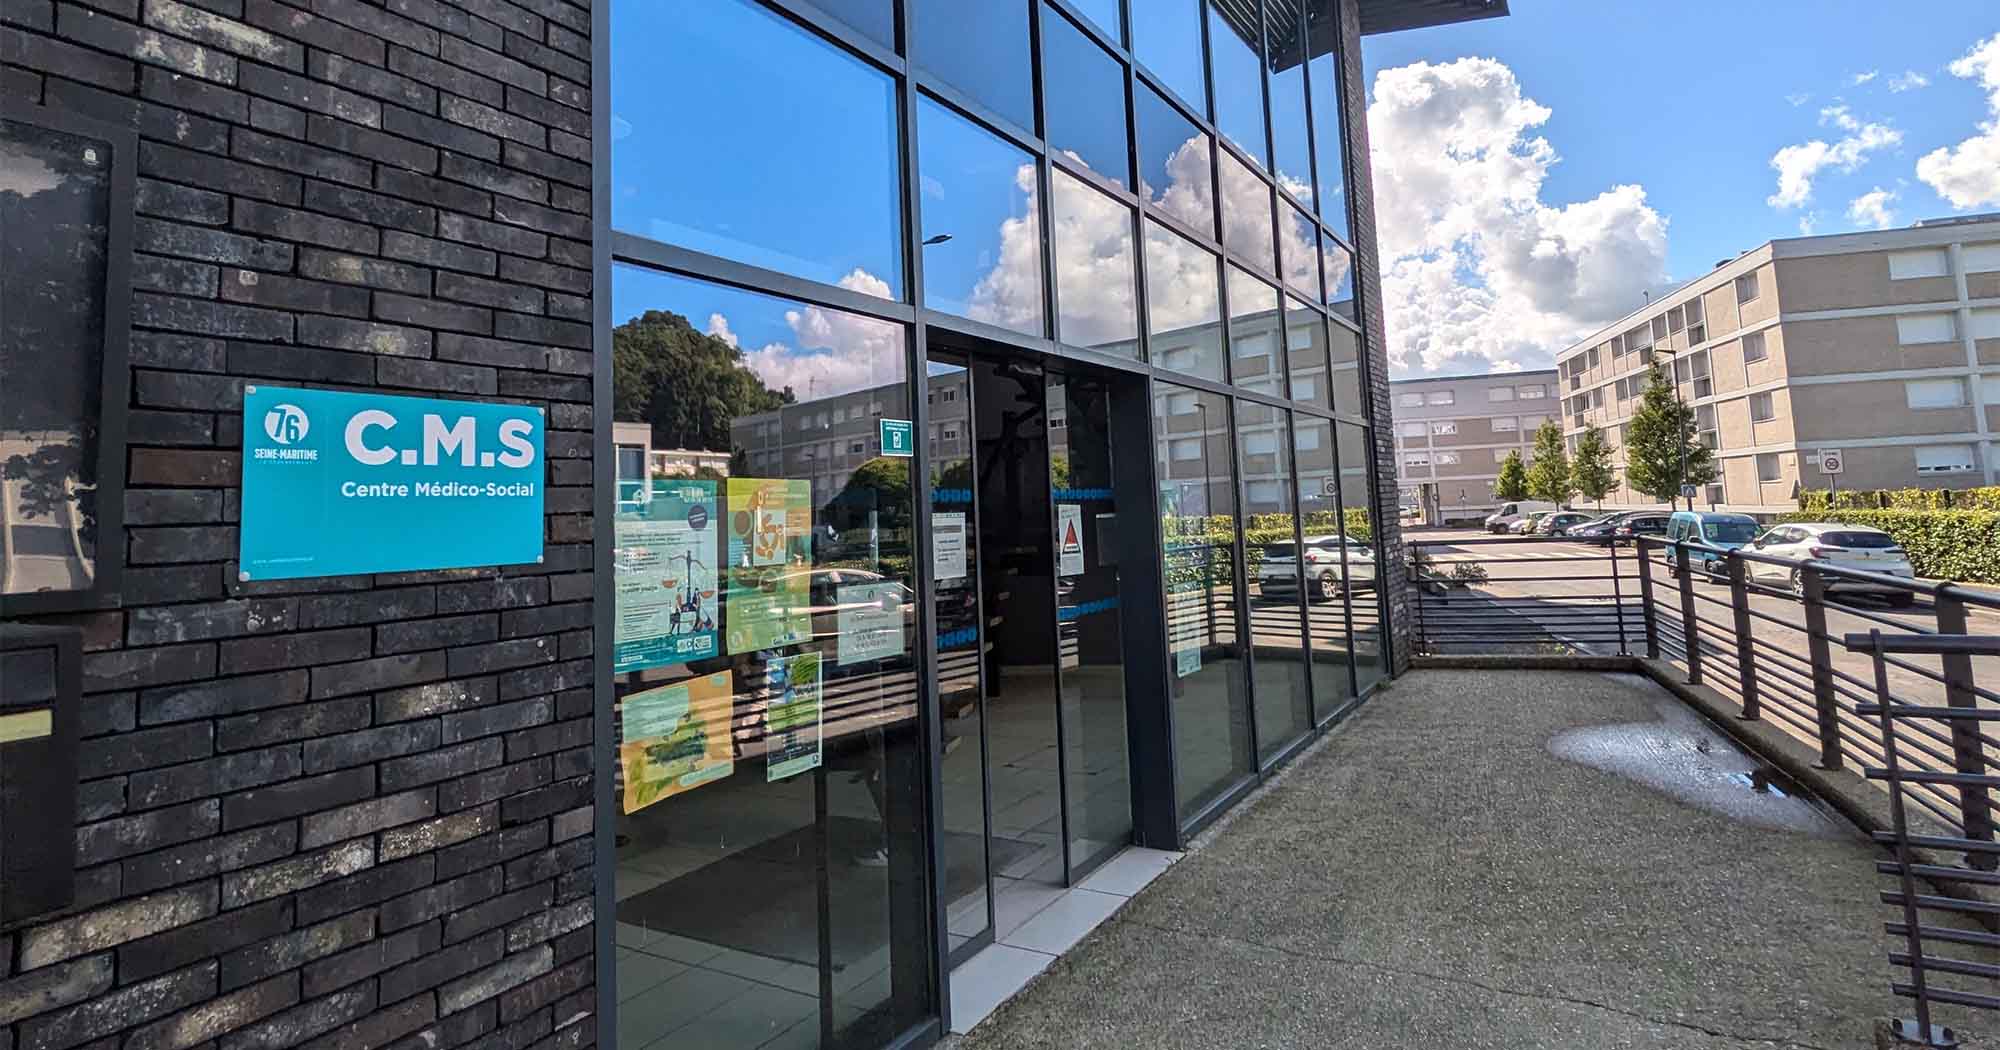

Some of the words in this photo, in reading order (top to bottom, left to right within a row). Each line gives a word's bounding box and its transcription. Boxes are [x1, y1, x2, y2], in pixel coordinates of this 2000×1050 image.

[268, 407, 301, 444] 76
[344, 409, 535, 469] C.M.S
[254, 447, 318, 461] SEINE-MARITIME
[341, 481, 409, 497] Centre
[415, 481, 534, 497] Médico-Social
